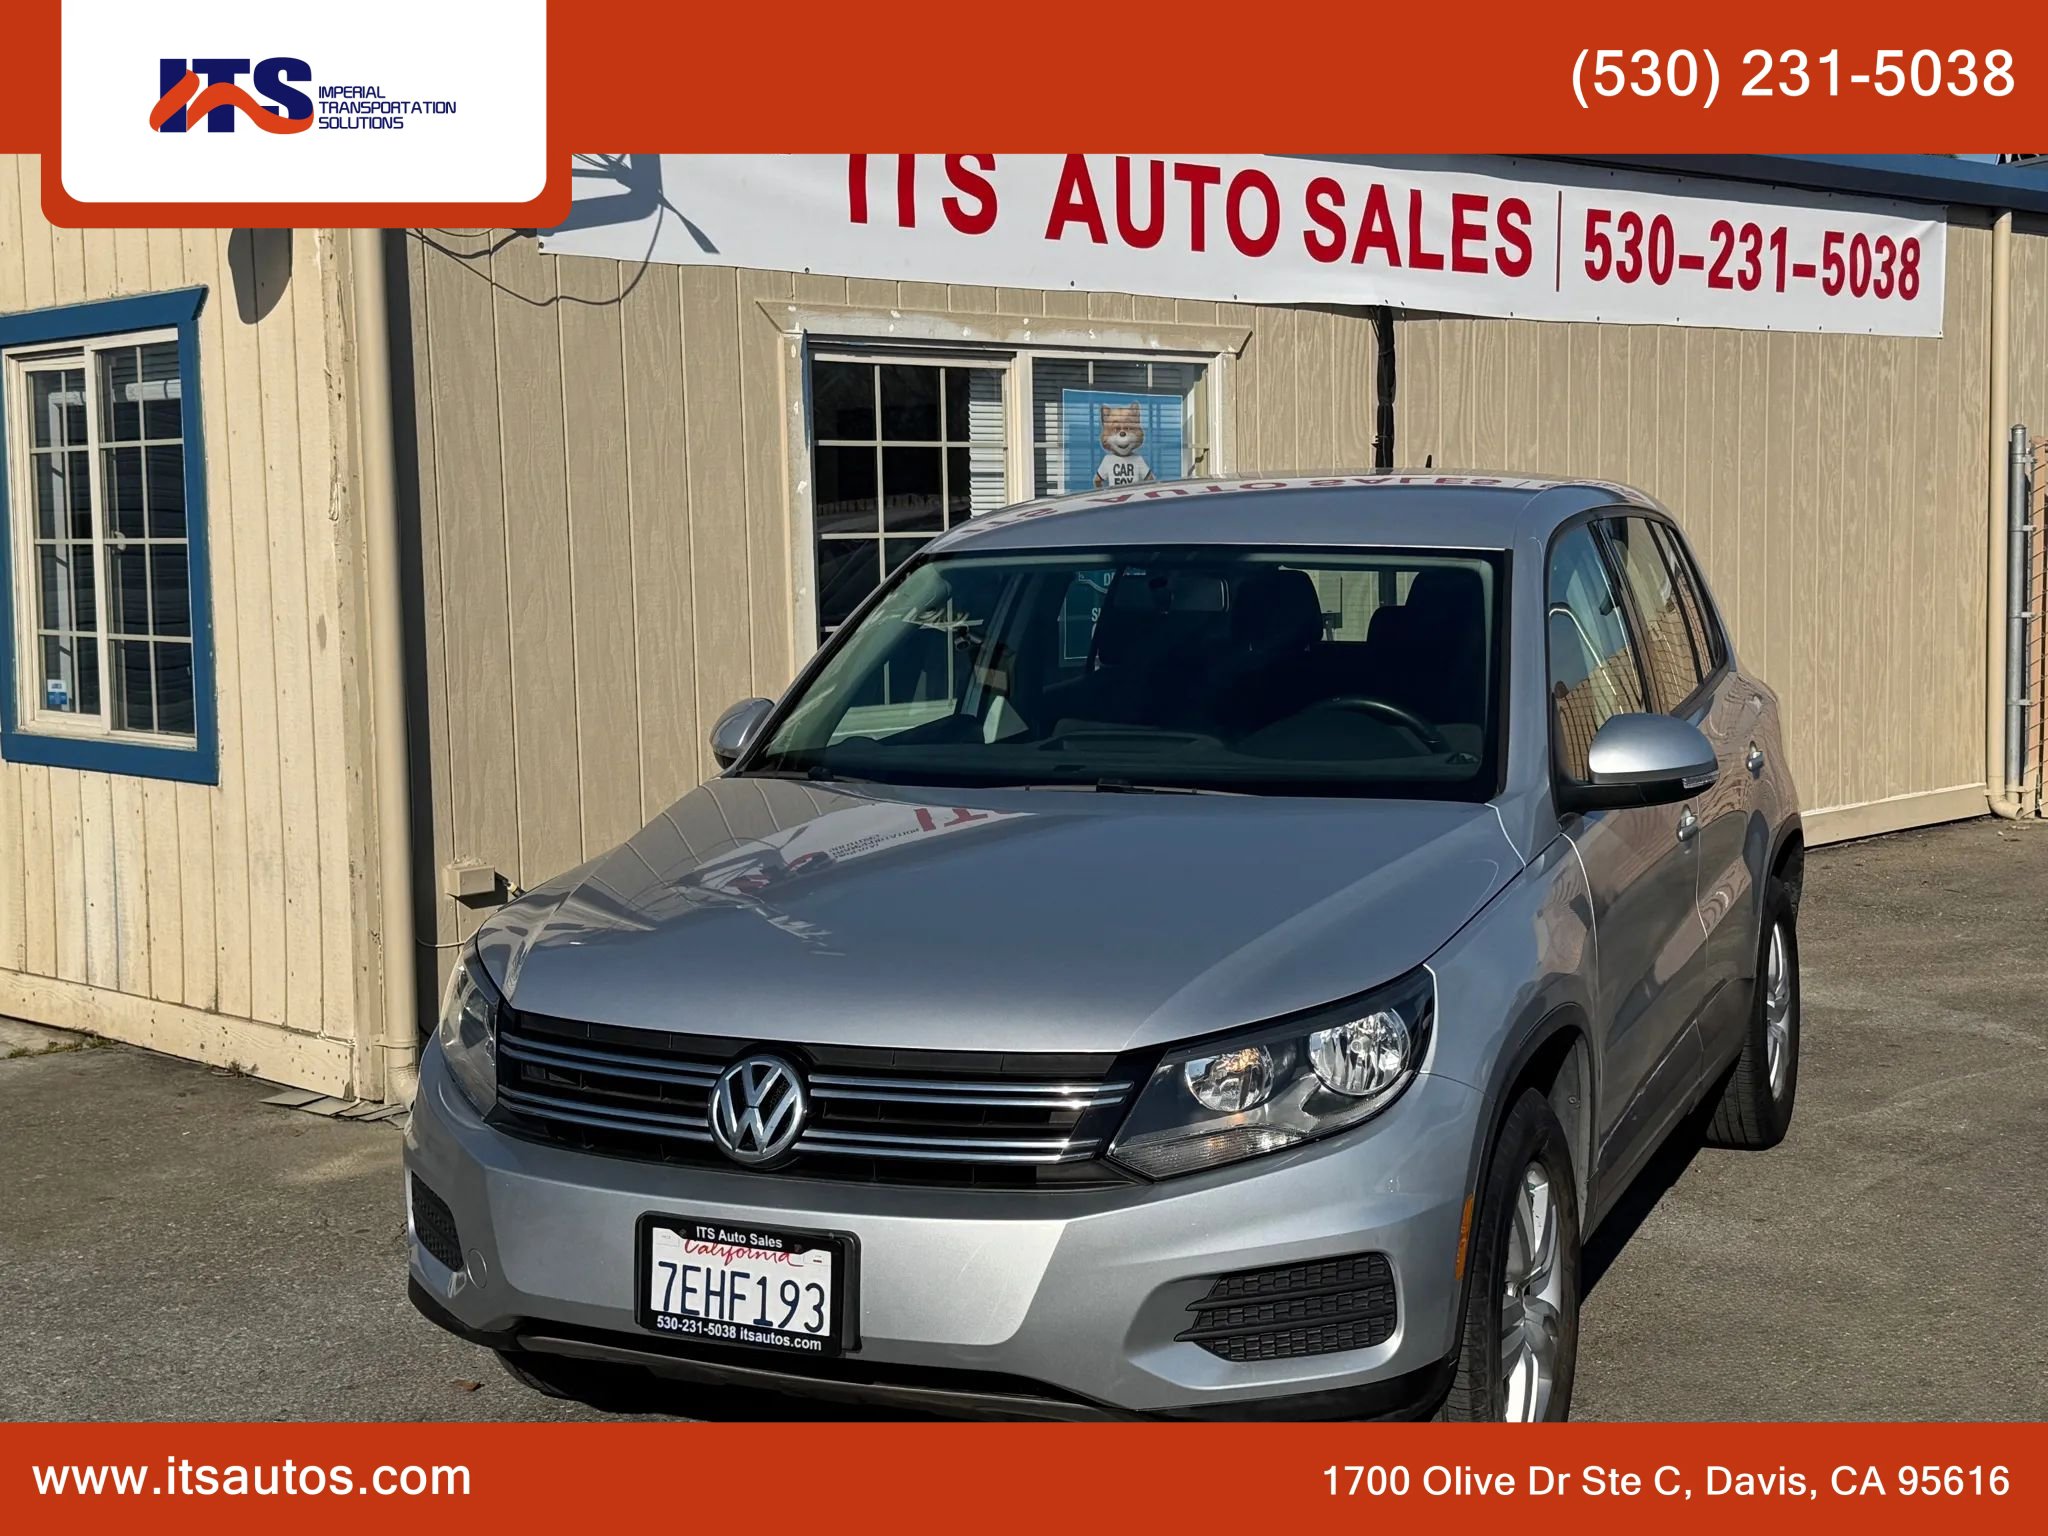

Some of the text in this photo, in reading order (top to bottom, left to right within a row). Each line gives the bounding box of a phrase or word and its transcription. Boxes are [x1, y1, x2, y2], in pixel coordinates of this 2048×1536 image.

[1045, 154, 1281, 258] AUTO
[1303, 177, 1533, 278] SALES
[1584, 208, 1921, 302] 530-231-5038
[1113, 463, 1135, 476] CAR
[696, 1225, 783, 1249] ITS Auto Sales
[658, 1260, 825, 1333] 7EHF193
[656, 1315, 822, 1352] 530-231-5038 itsautos.com
